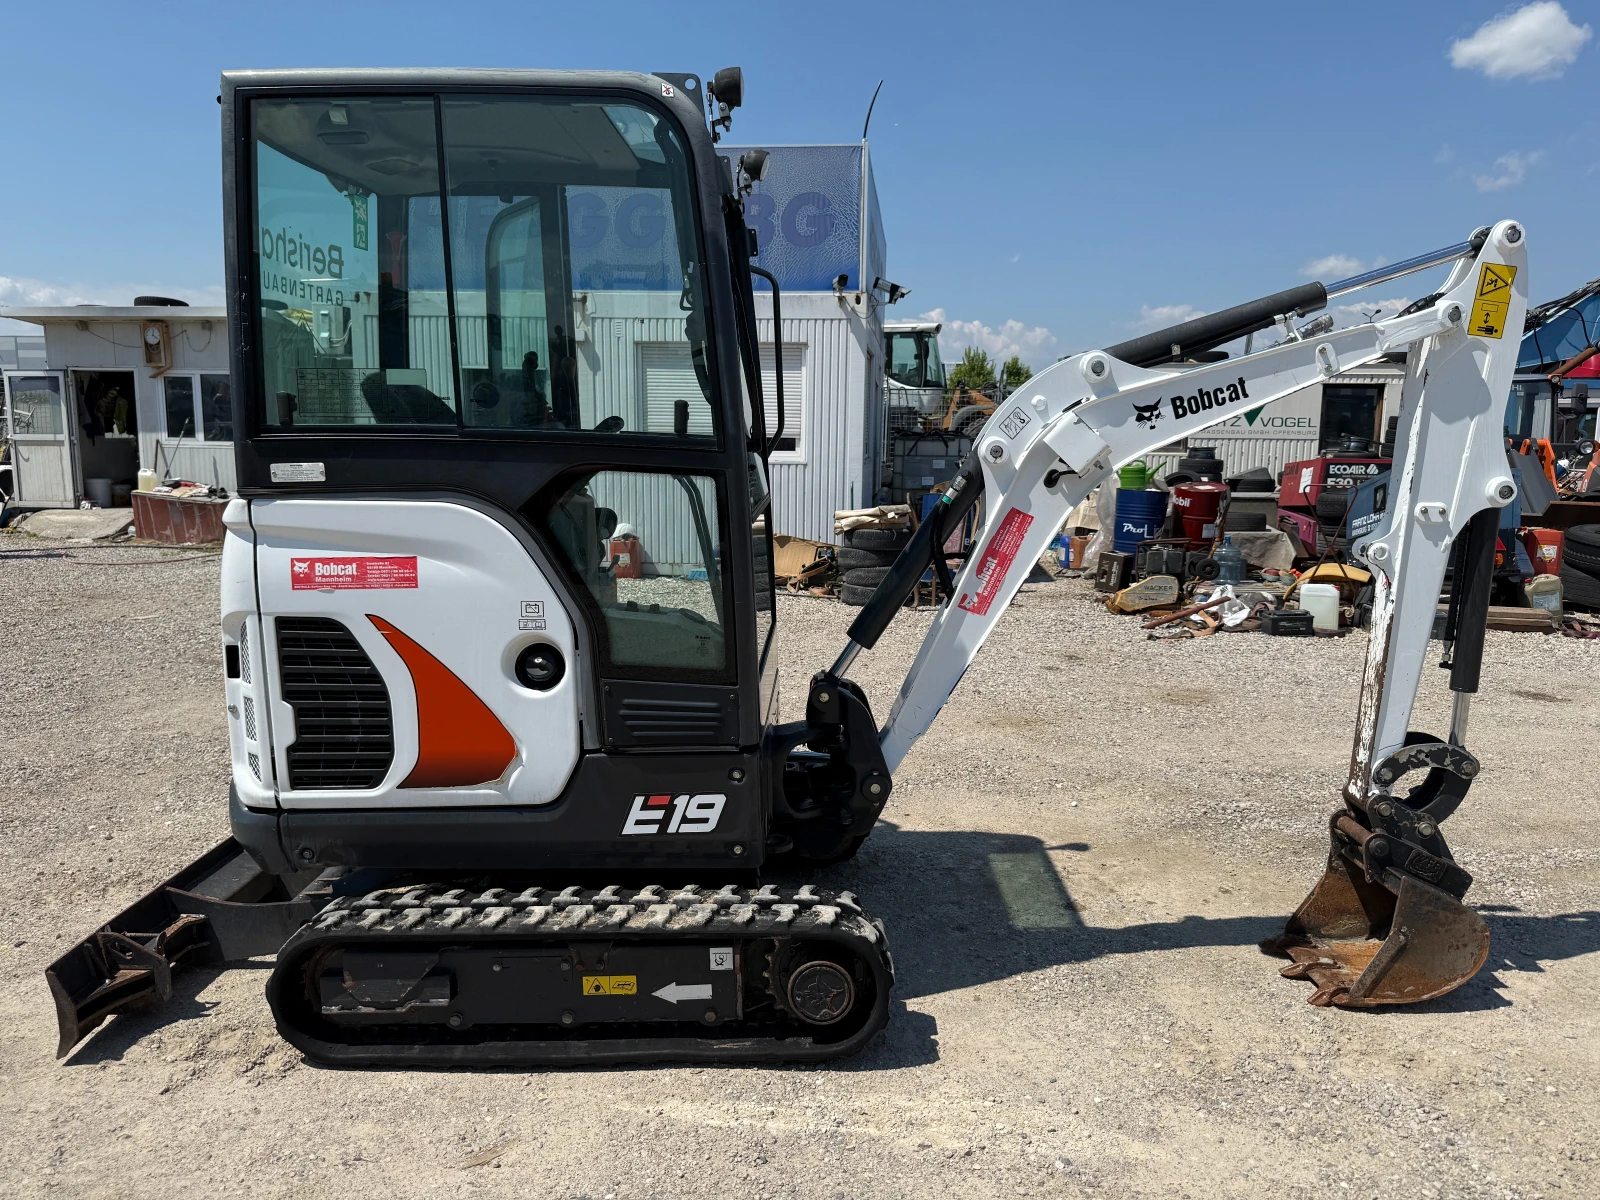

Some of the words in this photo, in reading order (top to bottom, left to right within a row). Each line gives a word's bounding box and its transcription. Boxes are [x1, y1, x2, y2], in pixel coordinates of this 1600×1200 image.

[1170, 376, 1250, 420] Bobcat
[1260, 416, 1318, 428] VOGEL
[1328, 464, 1366, 475] ECOAIR
[314, 562, 358, 576] Bobcat
[1143, 584, 1174, 592] WACKER
[621, 793, 727, 835] E19
